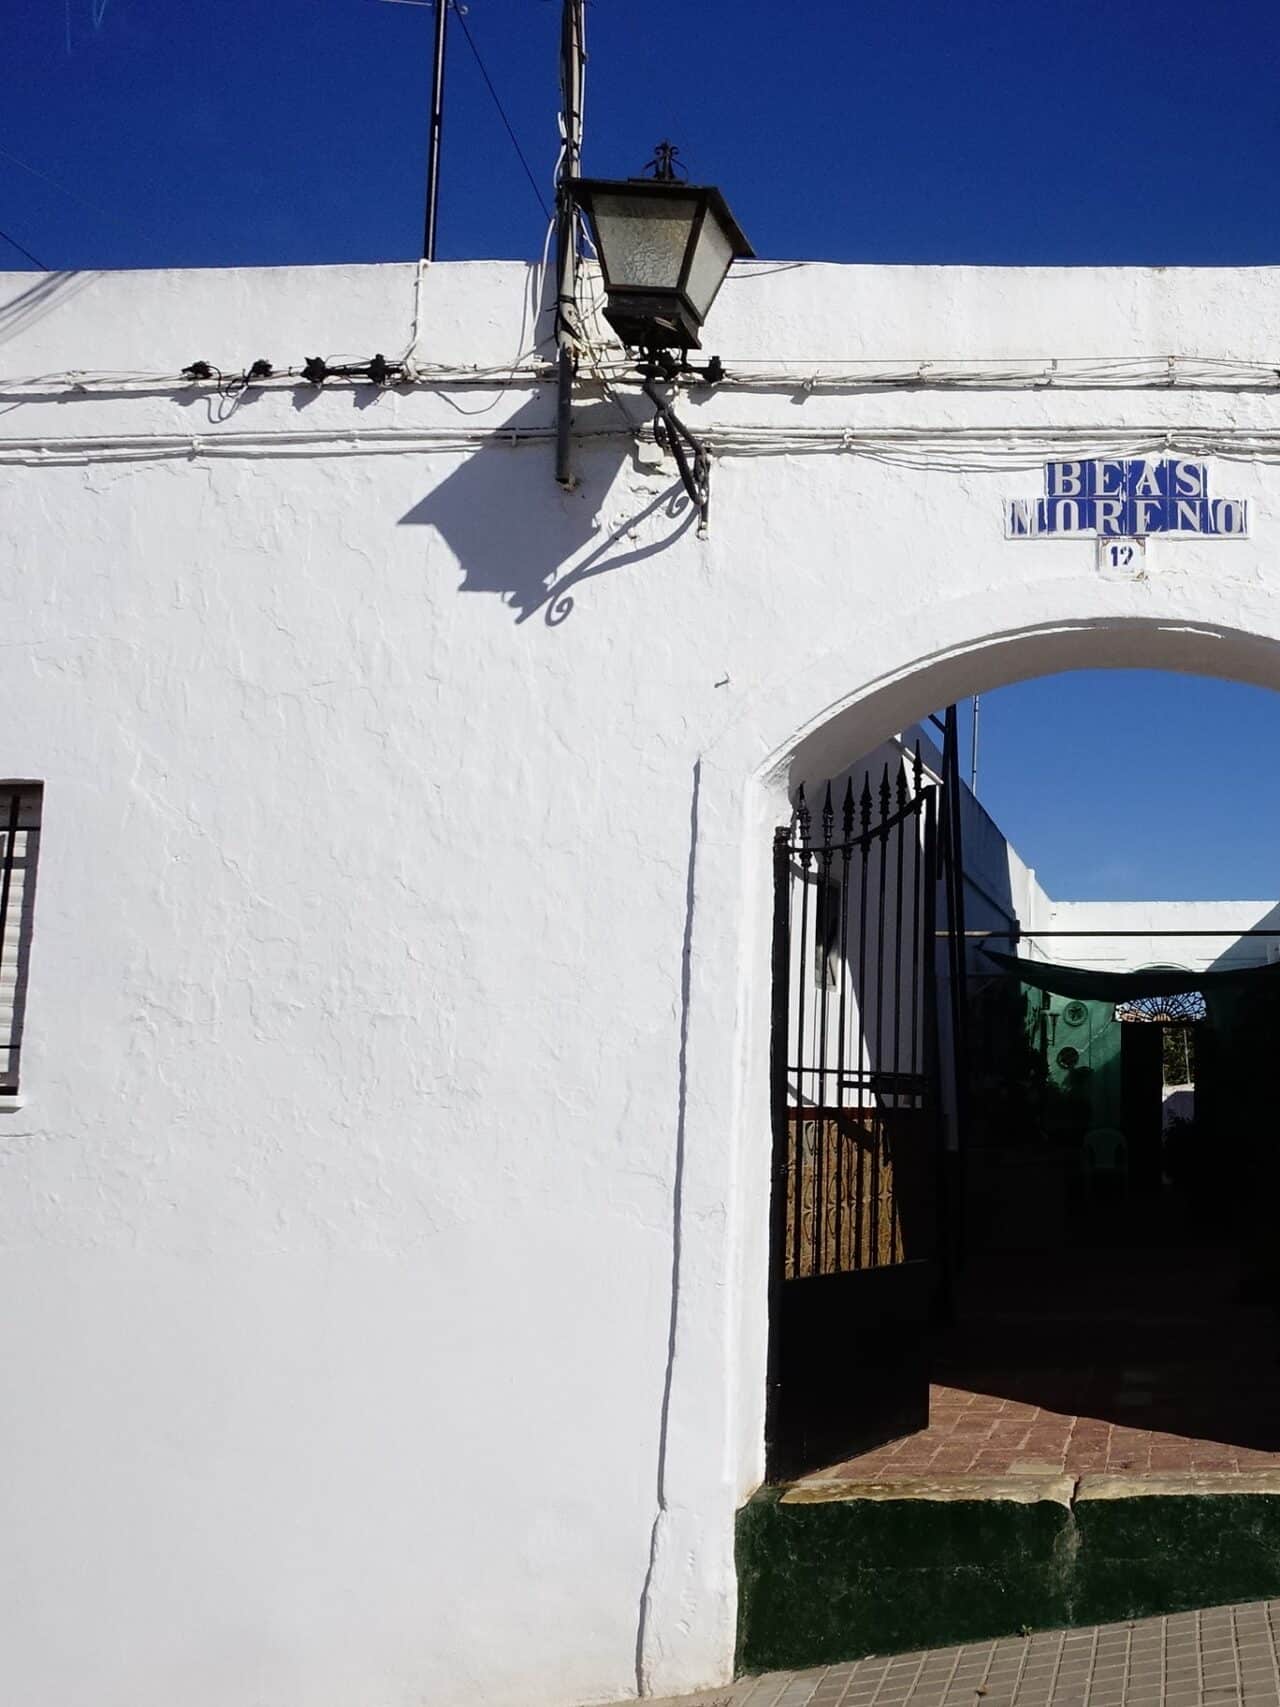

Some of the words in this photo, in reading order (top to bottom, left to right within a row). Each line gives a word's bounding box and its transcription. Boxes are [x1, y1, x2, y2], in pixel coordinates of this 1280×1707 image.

[1053, 462, 1201, 496] BEAS
[1008, 499, 1244, 534] MORENO
[1109, 546, 1134, 567] 12
